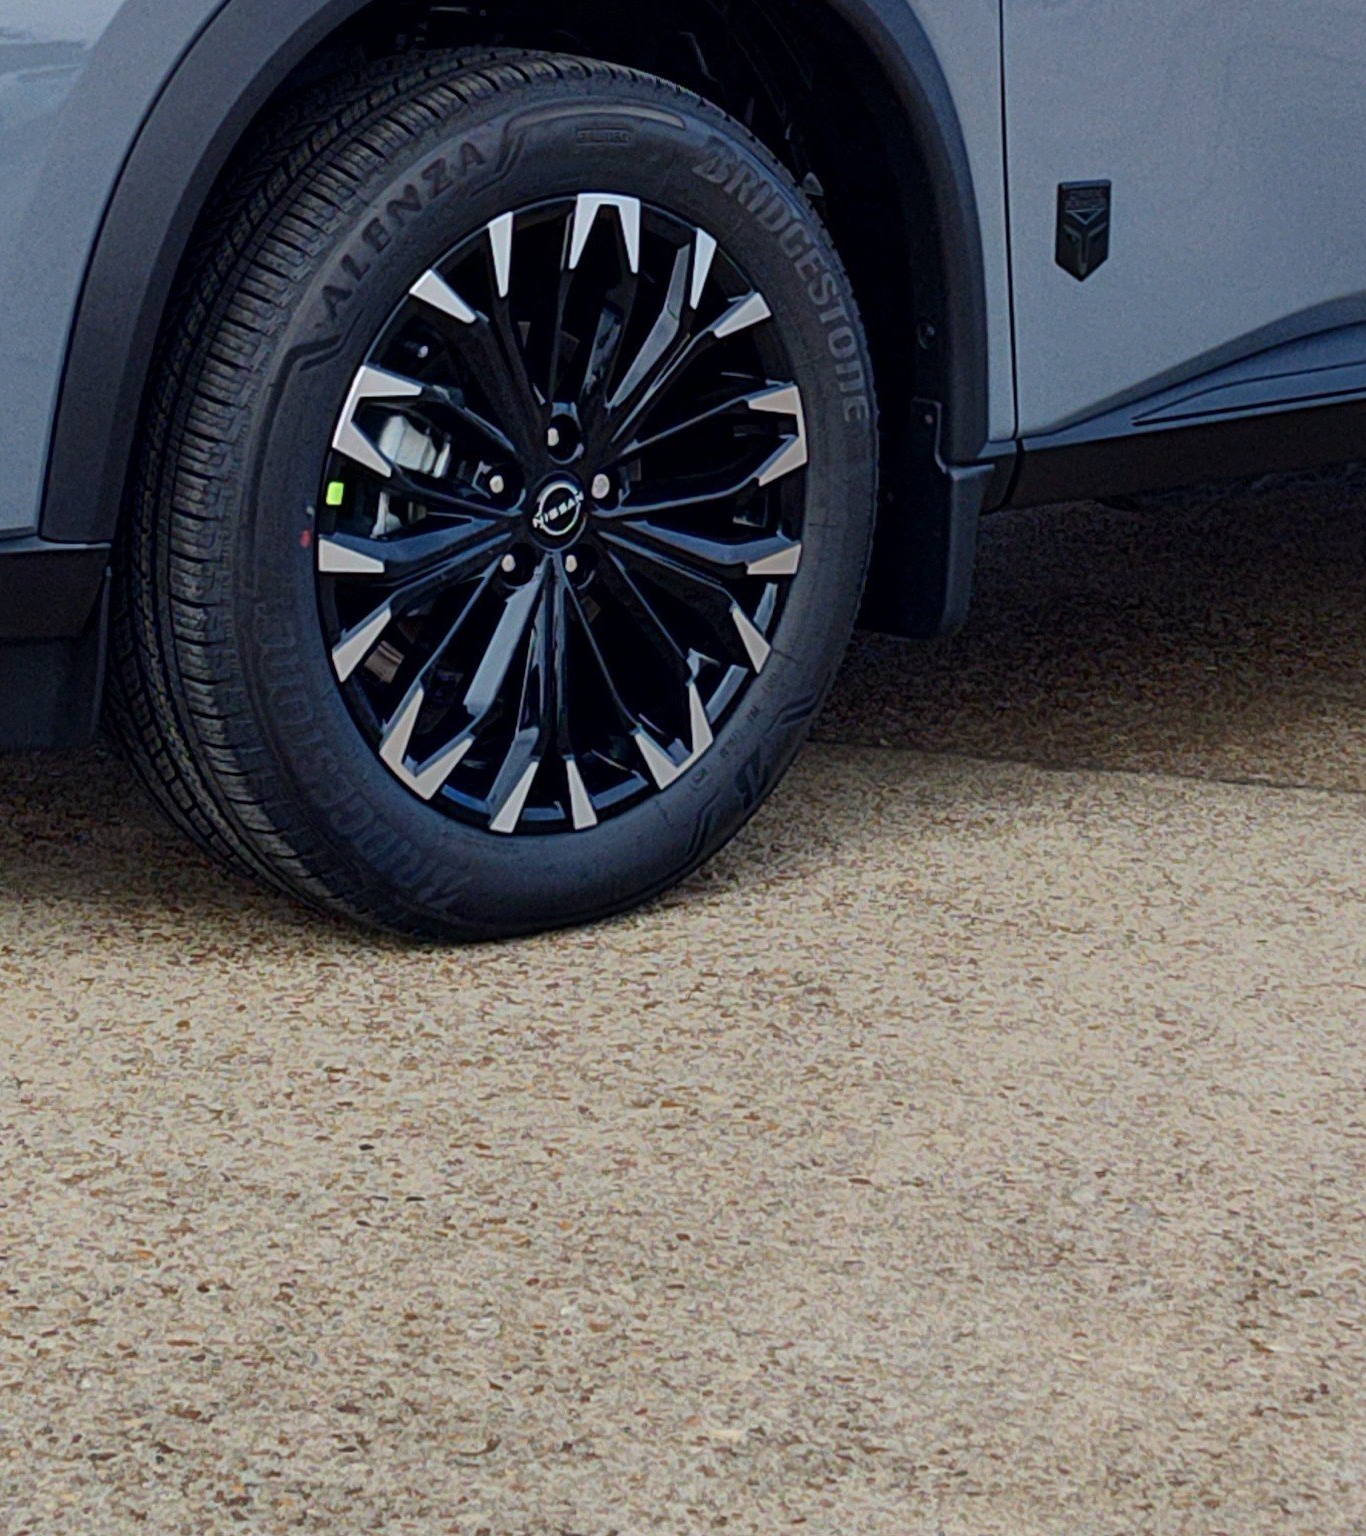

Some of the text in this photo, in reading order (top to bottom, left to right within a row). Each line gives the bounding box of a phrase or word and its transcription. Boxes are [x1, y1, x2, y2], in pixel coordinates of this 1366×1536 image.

[320, 140, 486, 320] ALENZA
[691, 134, 871, 424] BRIDGESTONE
[532, 491, 585, 529] NISSAN
